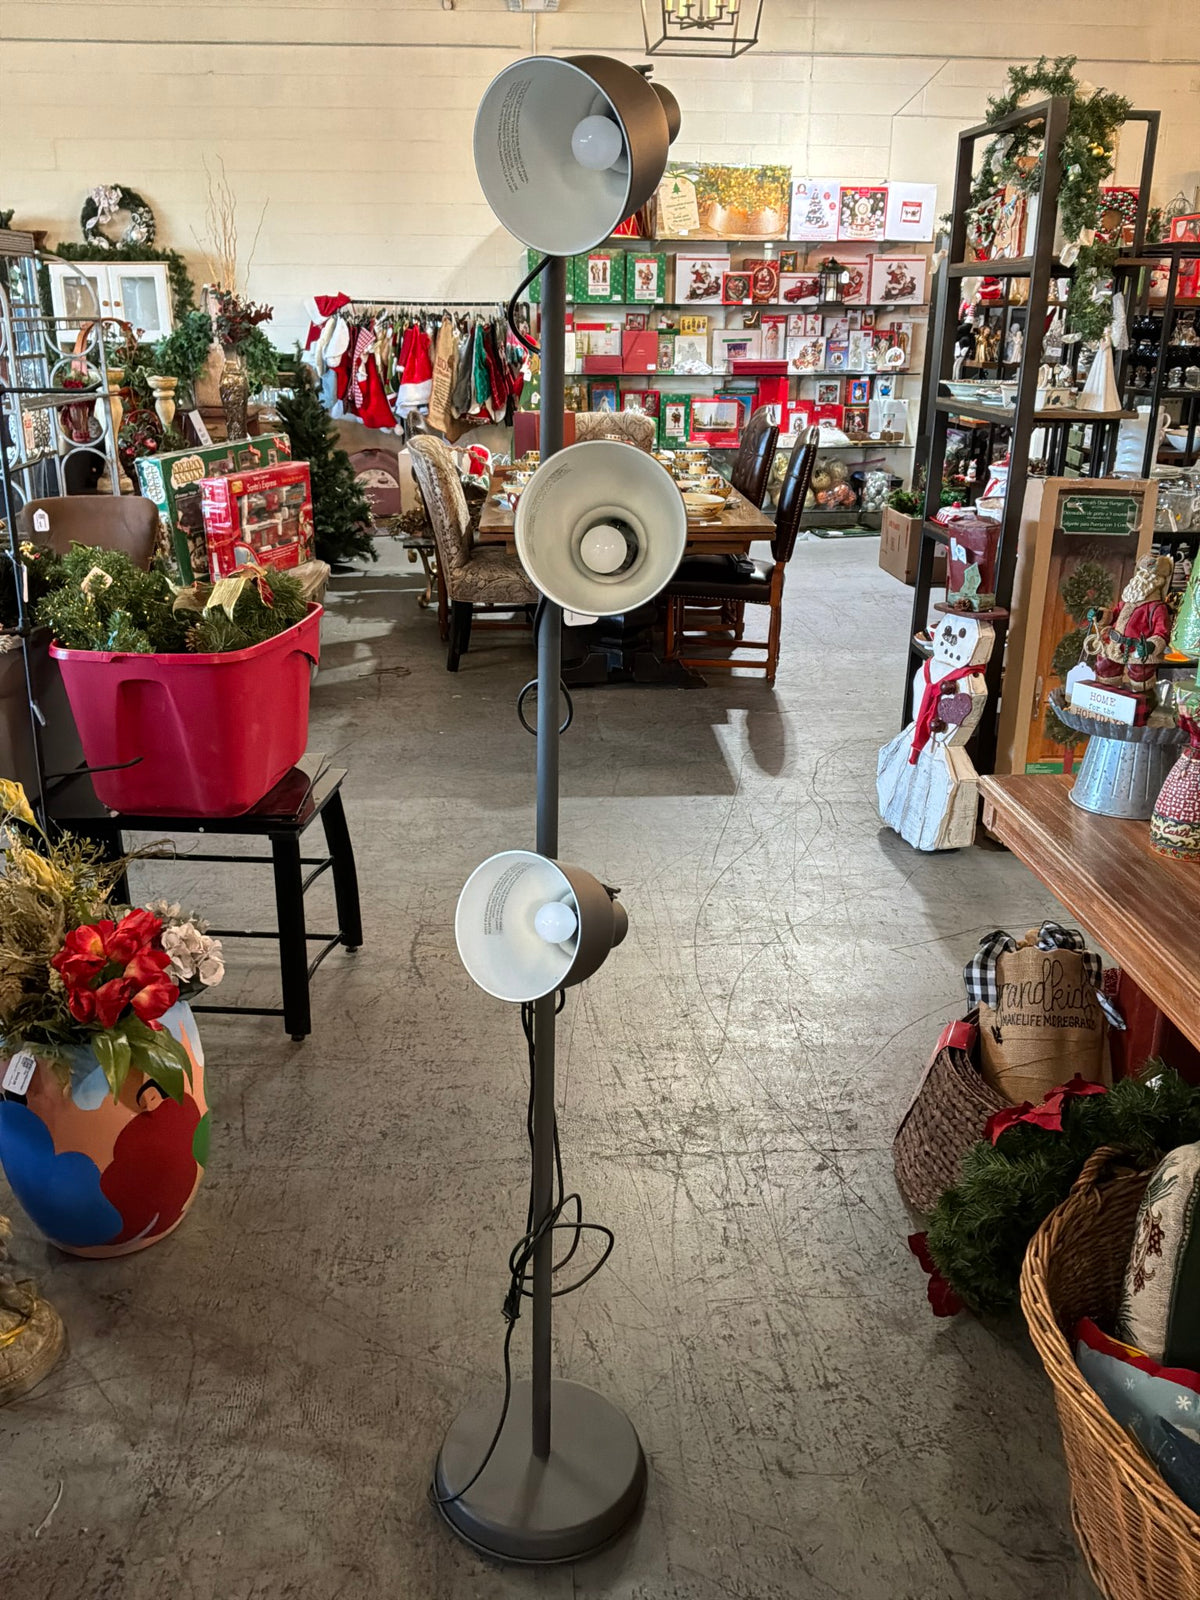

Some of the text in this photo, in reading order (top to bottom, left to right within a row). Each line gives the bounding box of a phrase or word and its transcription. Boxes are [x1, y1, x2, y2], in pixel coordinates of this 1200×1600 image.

[1089, 703, 1101, 712] for
[1090, 692, 1116, 707] HOME
[1075, 707, 1126, 725] HOLID
[997, 957, 1097, 1018] randkids
